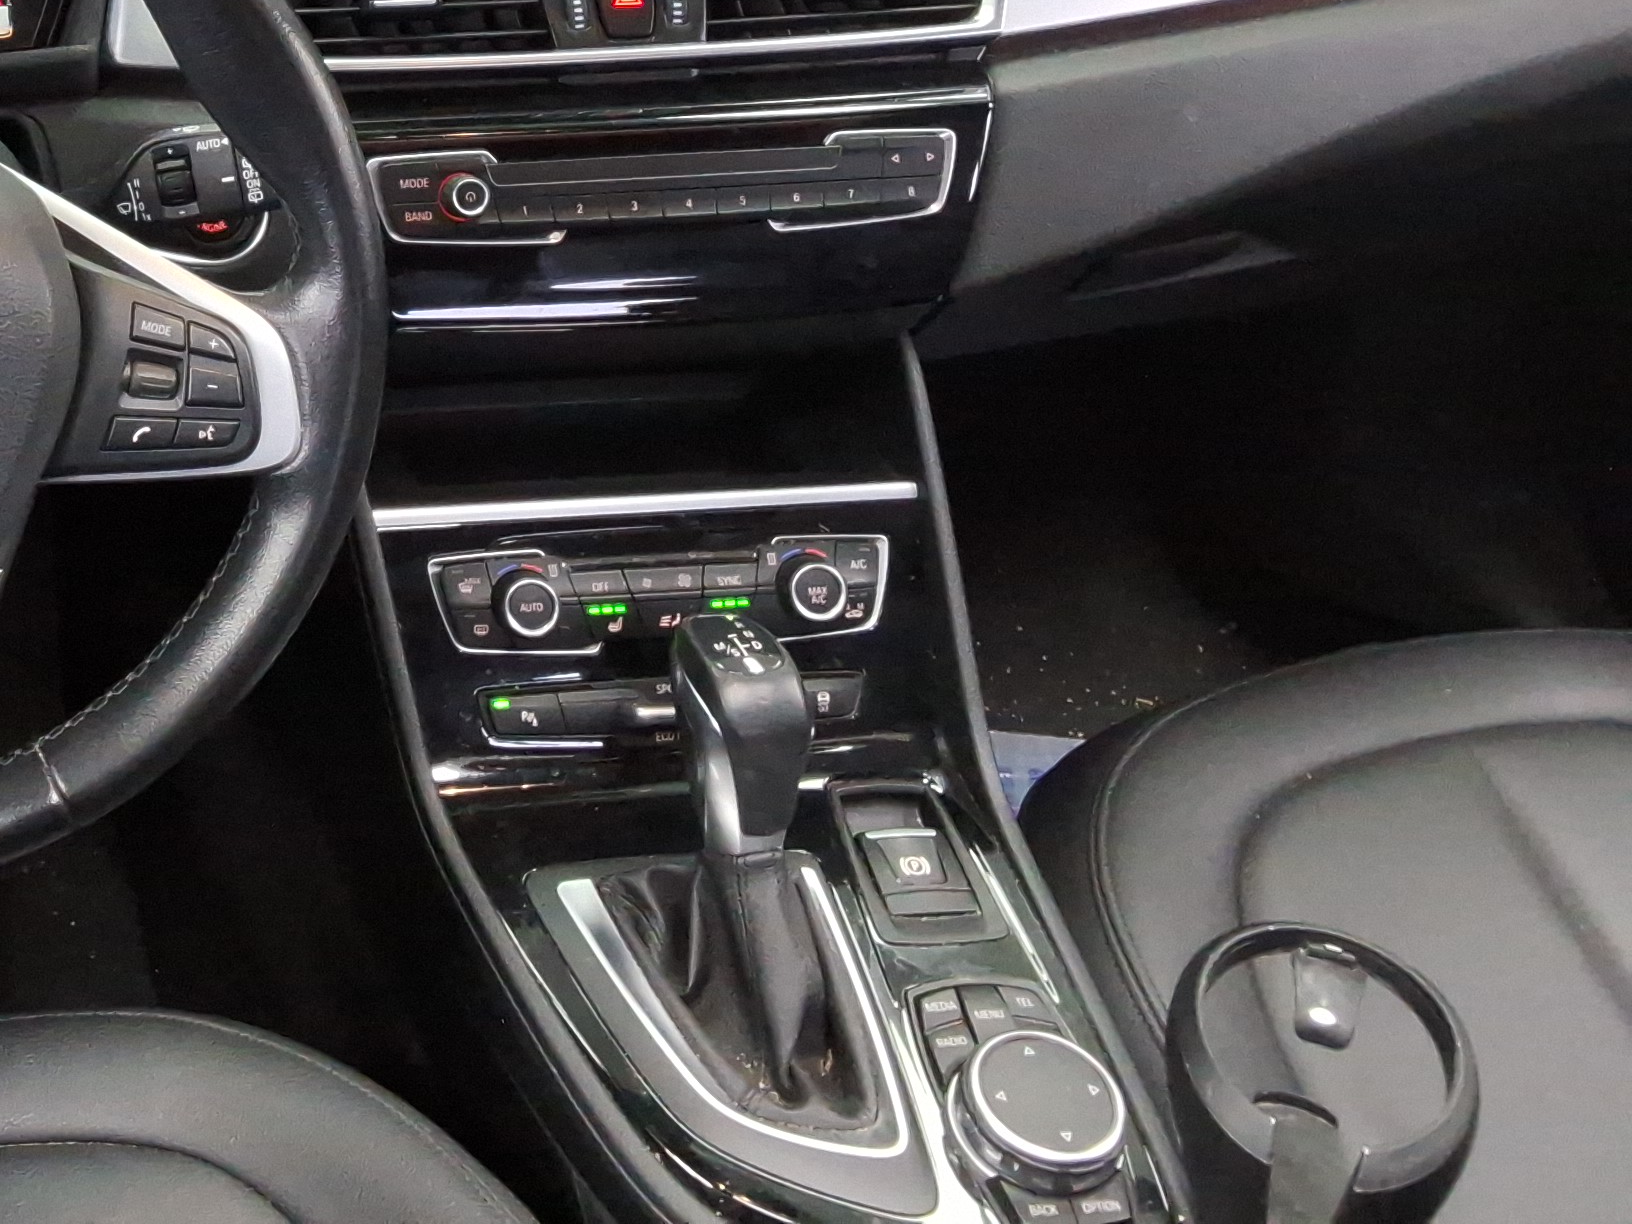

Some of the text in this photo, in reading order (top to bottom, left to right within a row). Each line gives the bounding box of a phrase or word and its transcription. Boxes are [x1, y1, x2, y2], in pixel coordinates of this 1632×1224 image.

[196, 138, 221, 152] AUTO
[246, 177, 261, 188] ON
[400, 178, 430, 189] MODE
[792, 192, 801, 203] 6
[847, 188, 854, 199] 7
[631, 200, 639, 212] 3
[685, 198, 693, 210] 4
[739, 195, 747, 206] 5
[576, 203, 584, 215] 2
[404, 211, 433, 222] BAND
[140, 320, 172, 337] MODE
[850, 558, 868, 570] A/C
[591, 581, 609, 592] OFF
[808, 586, 828, 596] MAX
[519, 602, 544, 613] AUTO
